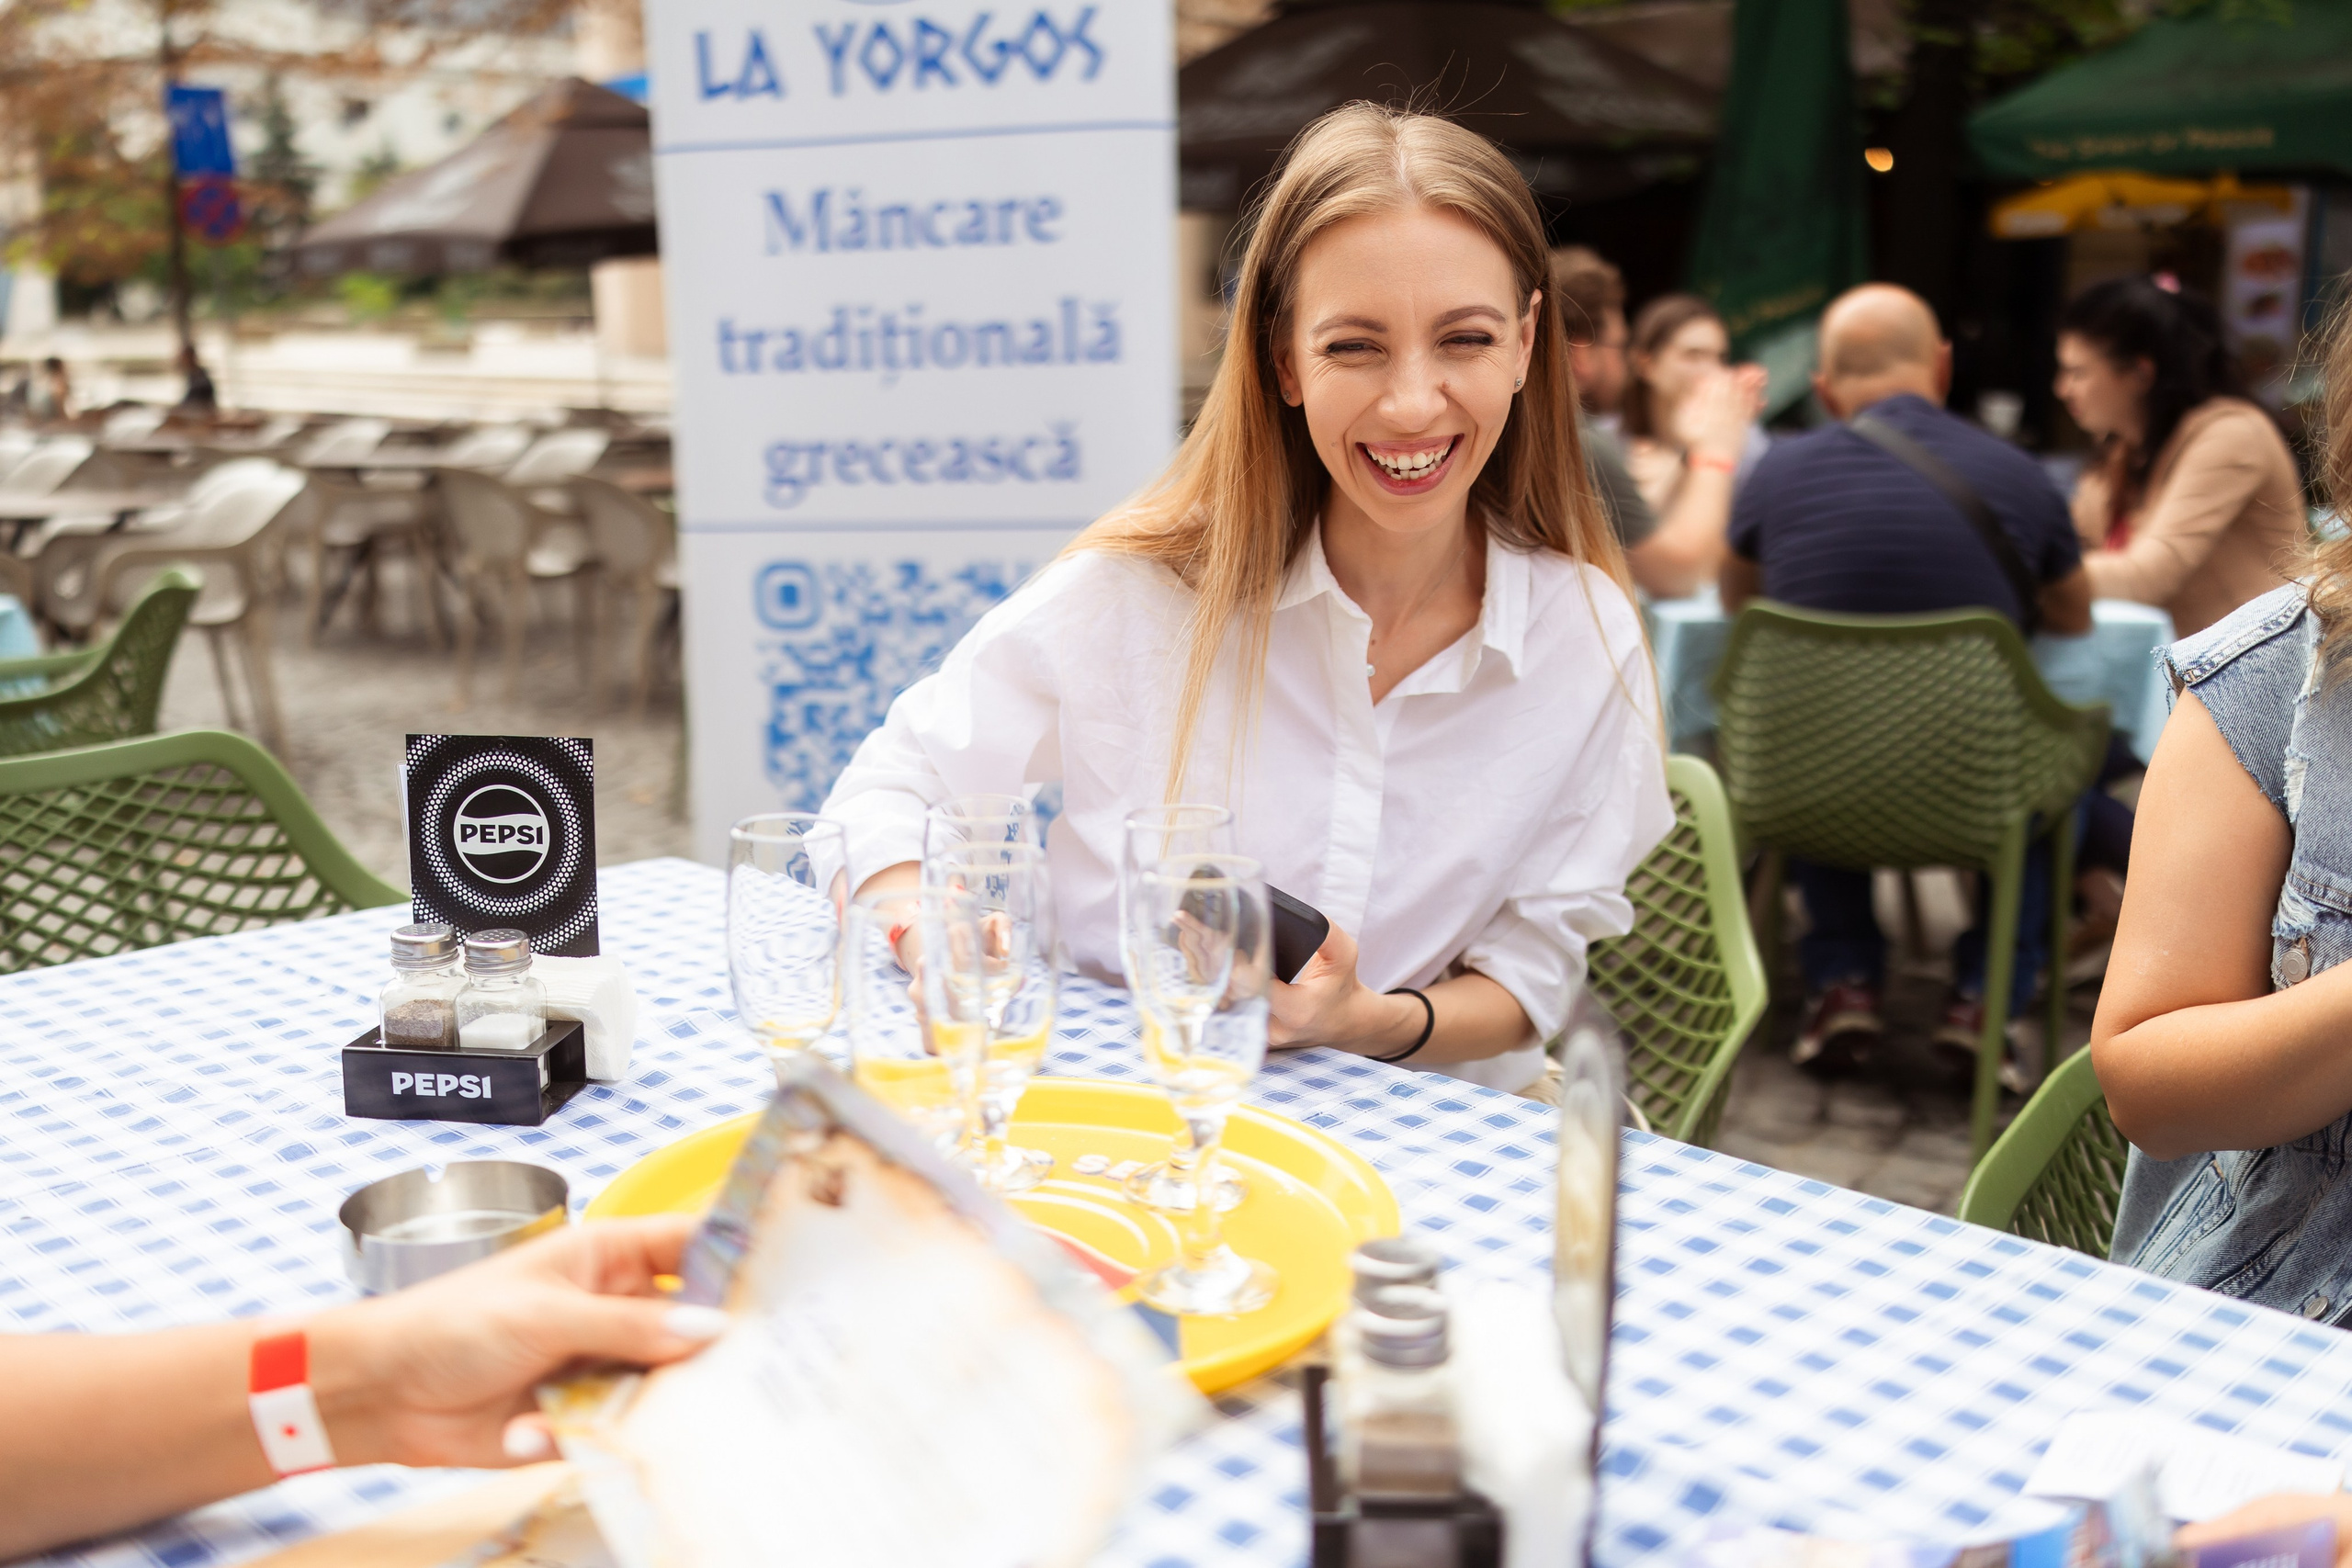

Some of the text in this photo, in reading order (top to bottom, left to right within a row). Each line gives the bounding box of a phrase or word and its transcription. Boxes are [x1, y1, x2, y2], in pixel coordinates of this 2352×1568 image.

[693, 7, 1108, 100] LA YORGOS
[763, 421, 1081, 509] grecească
[460, 823, 544, 845] PEPSI
[391, 1071, 492, 1099] PEPSI
